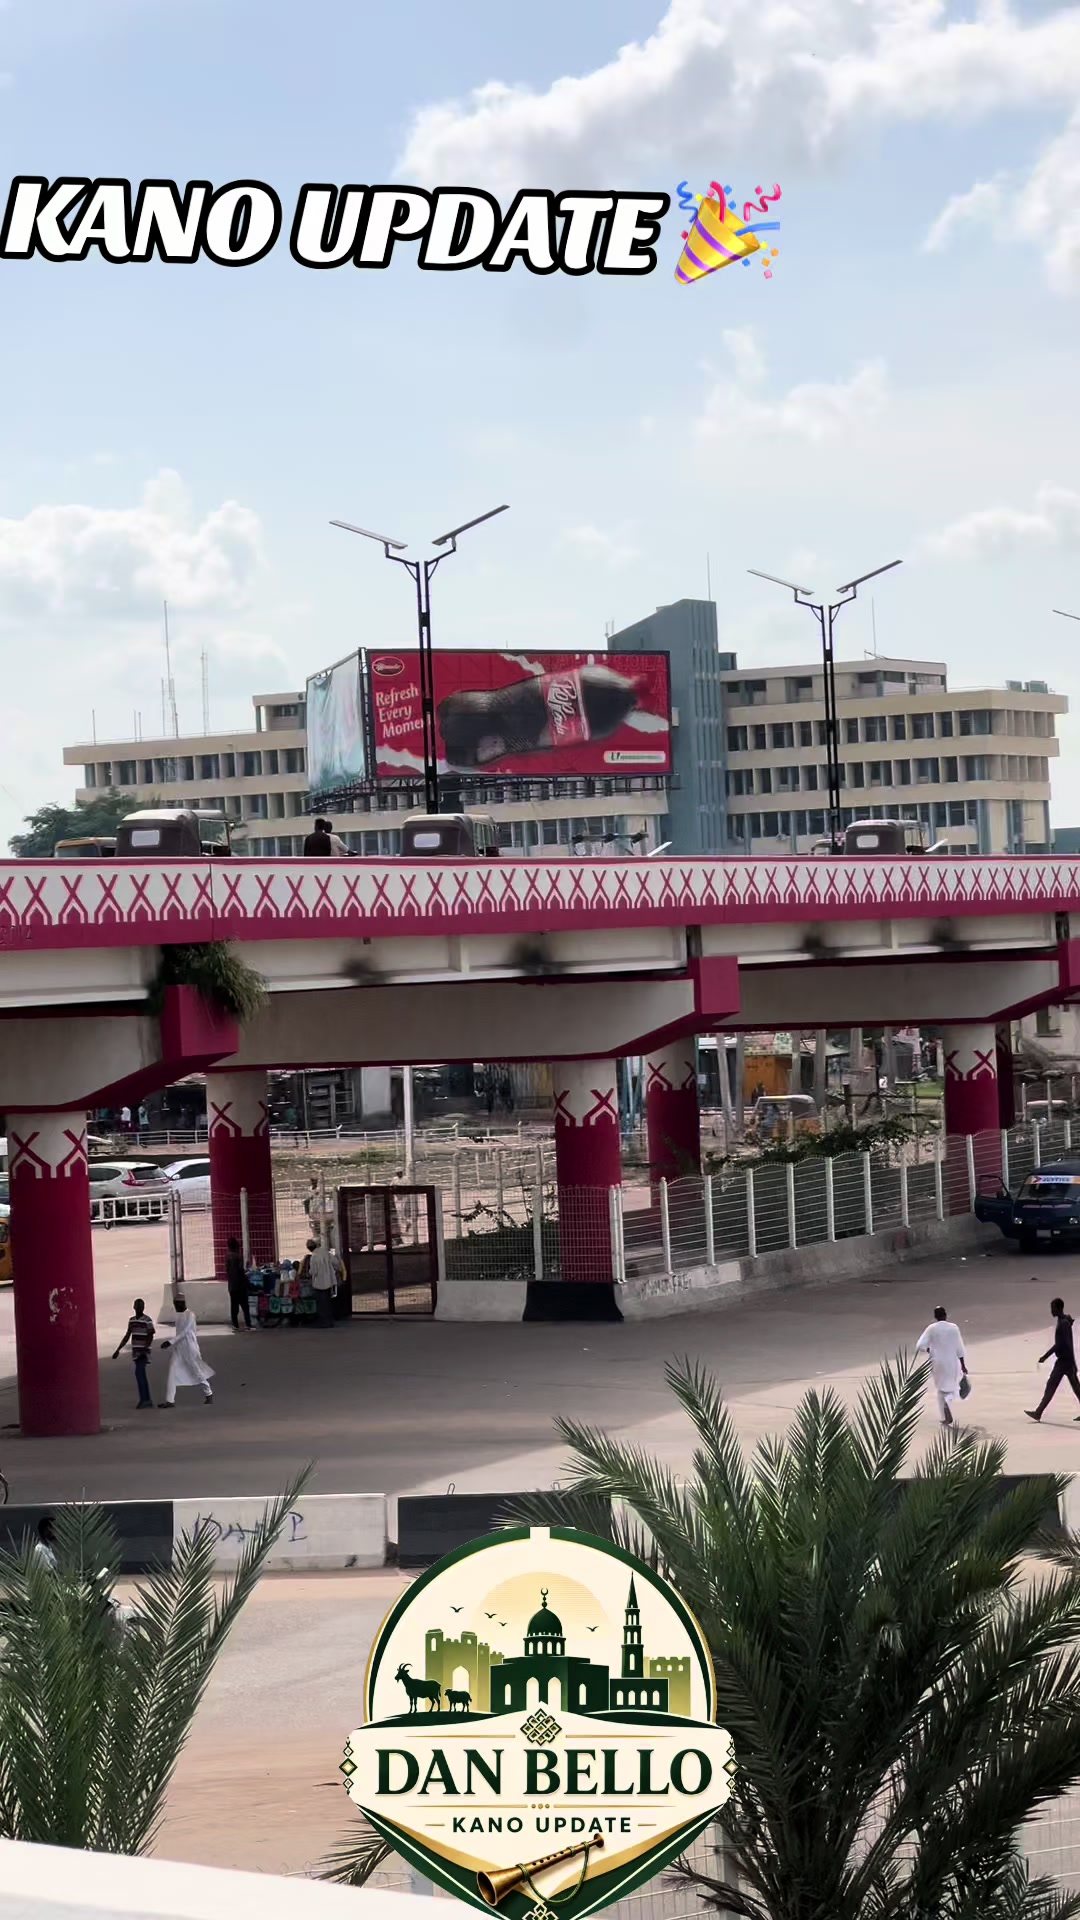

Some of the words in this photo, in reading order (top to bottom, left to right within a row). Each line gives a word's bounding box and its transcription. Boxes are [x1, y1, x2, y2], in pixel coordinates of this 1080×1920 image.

[375, 682, 419, 708] Refresh
[378, 705, 412, 723] Every
[383, 717, 430, 739] Momen
